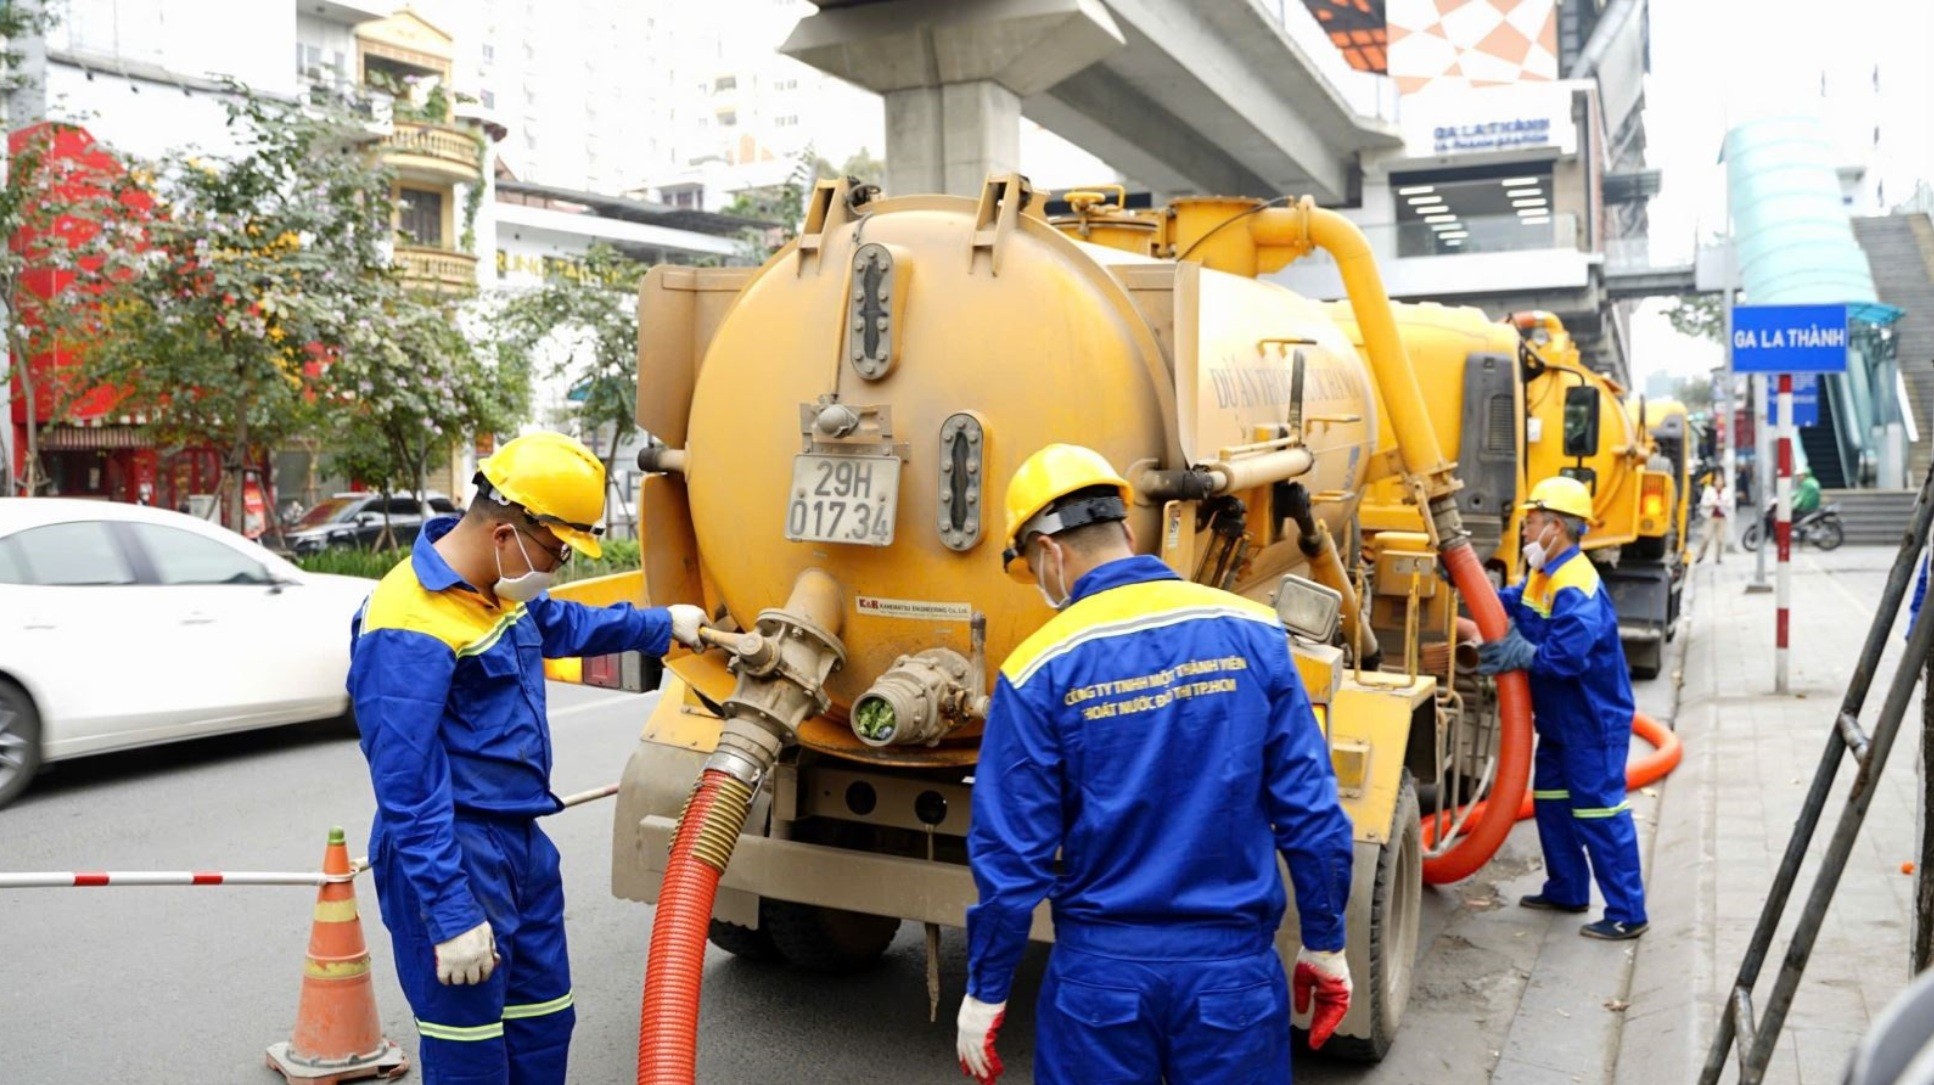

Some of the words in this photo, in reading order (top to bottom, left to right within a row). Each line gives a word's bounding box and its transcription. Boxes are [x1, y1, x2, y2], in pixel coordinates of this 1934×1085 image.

[1434, 127, 1456, 139] GA
[1461, 124, 1485, 137] LA
[1734, 330, 1757, 348] GA
[1761, 330, 1785, 348] LA
[1786, 323, 1845, 348] THÀNH
[814, 461, 872, 499] 29H
[789, 500, 889, 542] 017.34
[1065, 686, 1096, 706] CÔNG
[1095, 683, 1113, 697] TY
[1113, 676, 1148, 694] TNHH
[1174, 659, 1219, 678] THÀNH
[1220, 655, 1247, 671] VIÊN
[1118, 695, 1156, 715] NƯỚC
[1155, 688, 1174, 708] ĐÔ
[1172, 684, 1193, 700] THỊ
[1193, 678, 1237, 697] TP.HCM
